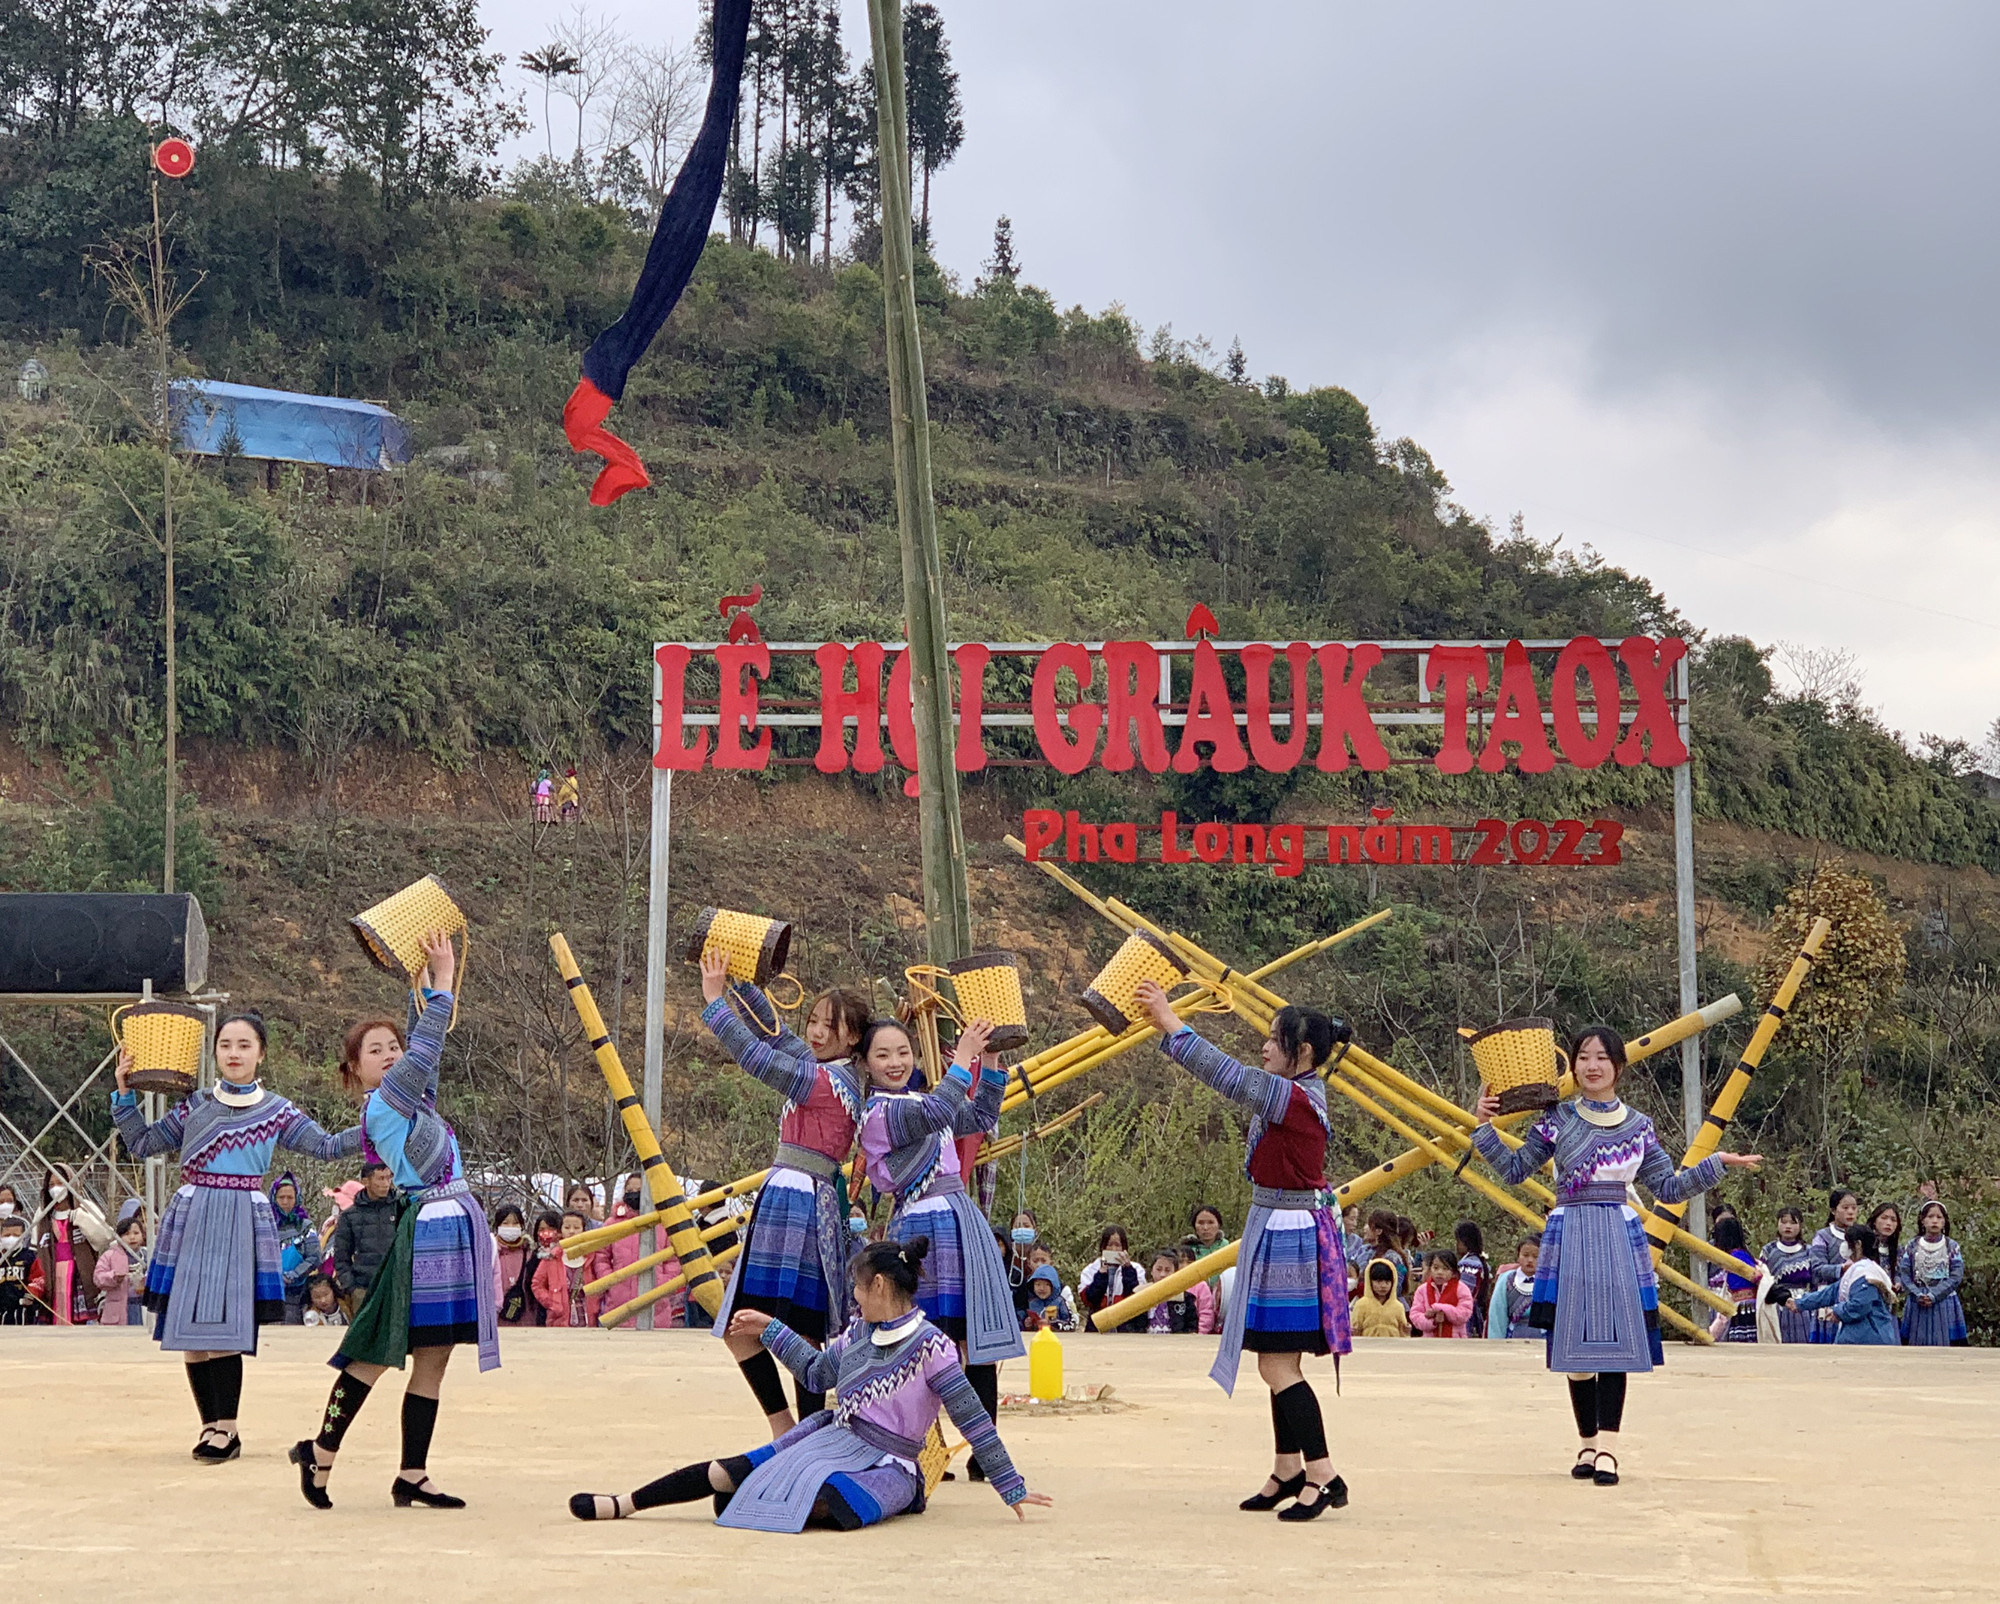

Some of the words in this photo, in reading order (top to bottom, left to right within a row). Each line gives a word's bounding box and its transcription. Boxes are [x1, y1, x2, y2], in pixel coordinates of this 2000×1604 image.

[653, 583, 772, 772] LỄ
[1031, 603, 1390, 774] GRÂUK
[1424, 635, 1688, 774] TAOX
[1022, 808, 1137, 863] Pha
[1161, 810, 1304, 877] Long
[1327, 807, 1452, 865] năm
[1471, 819, 1623, 865] 2023
